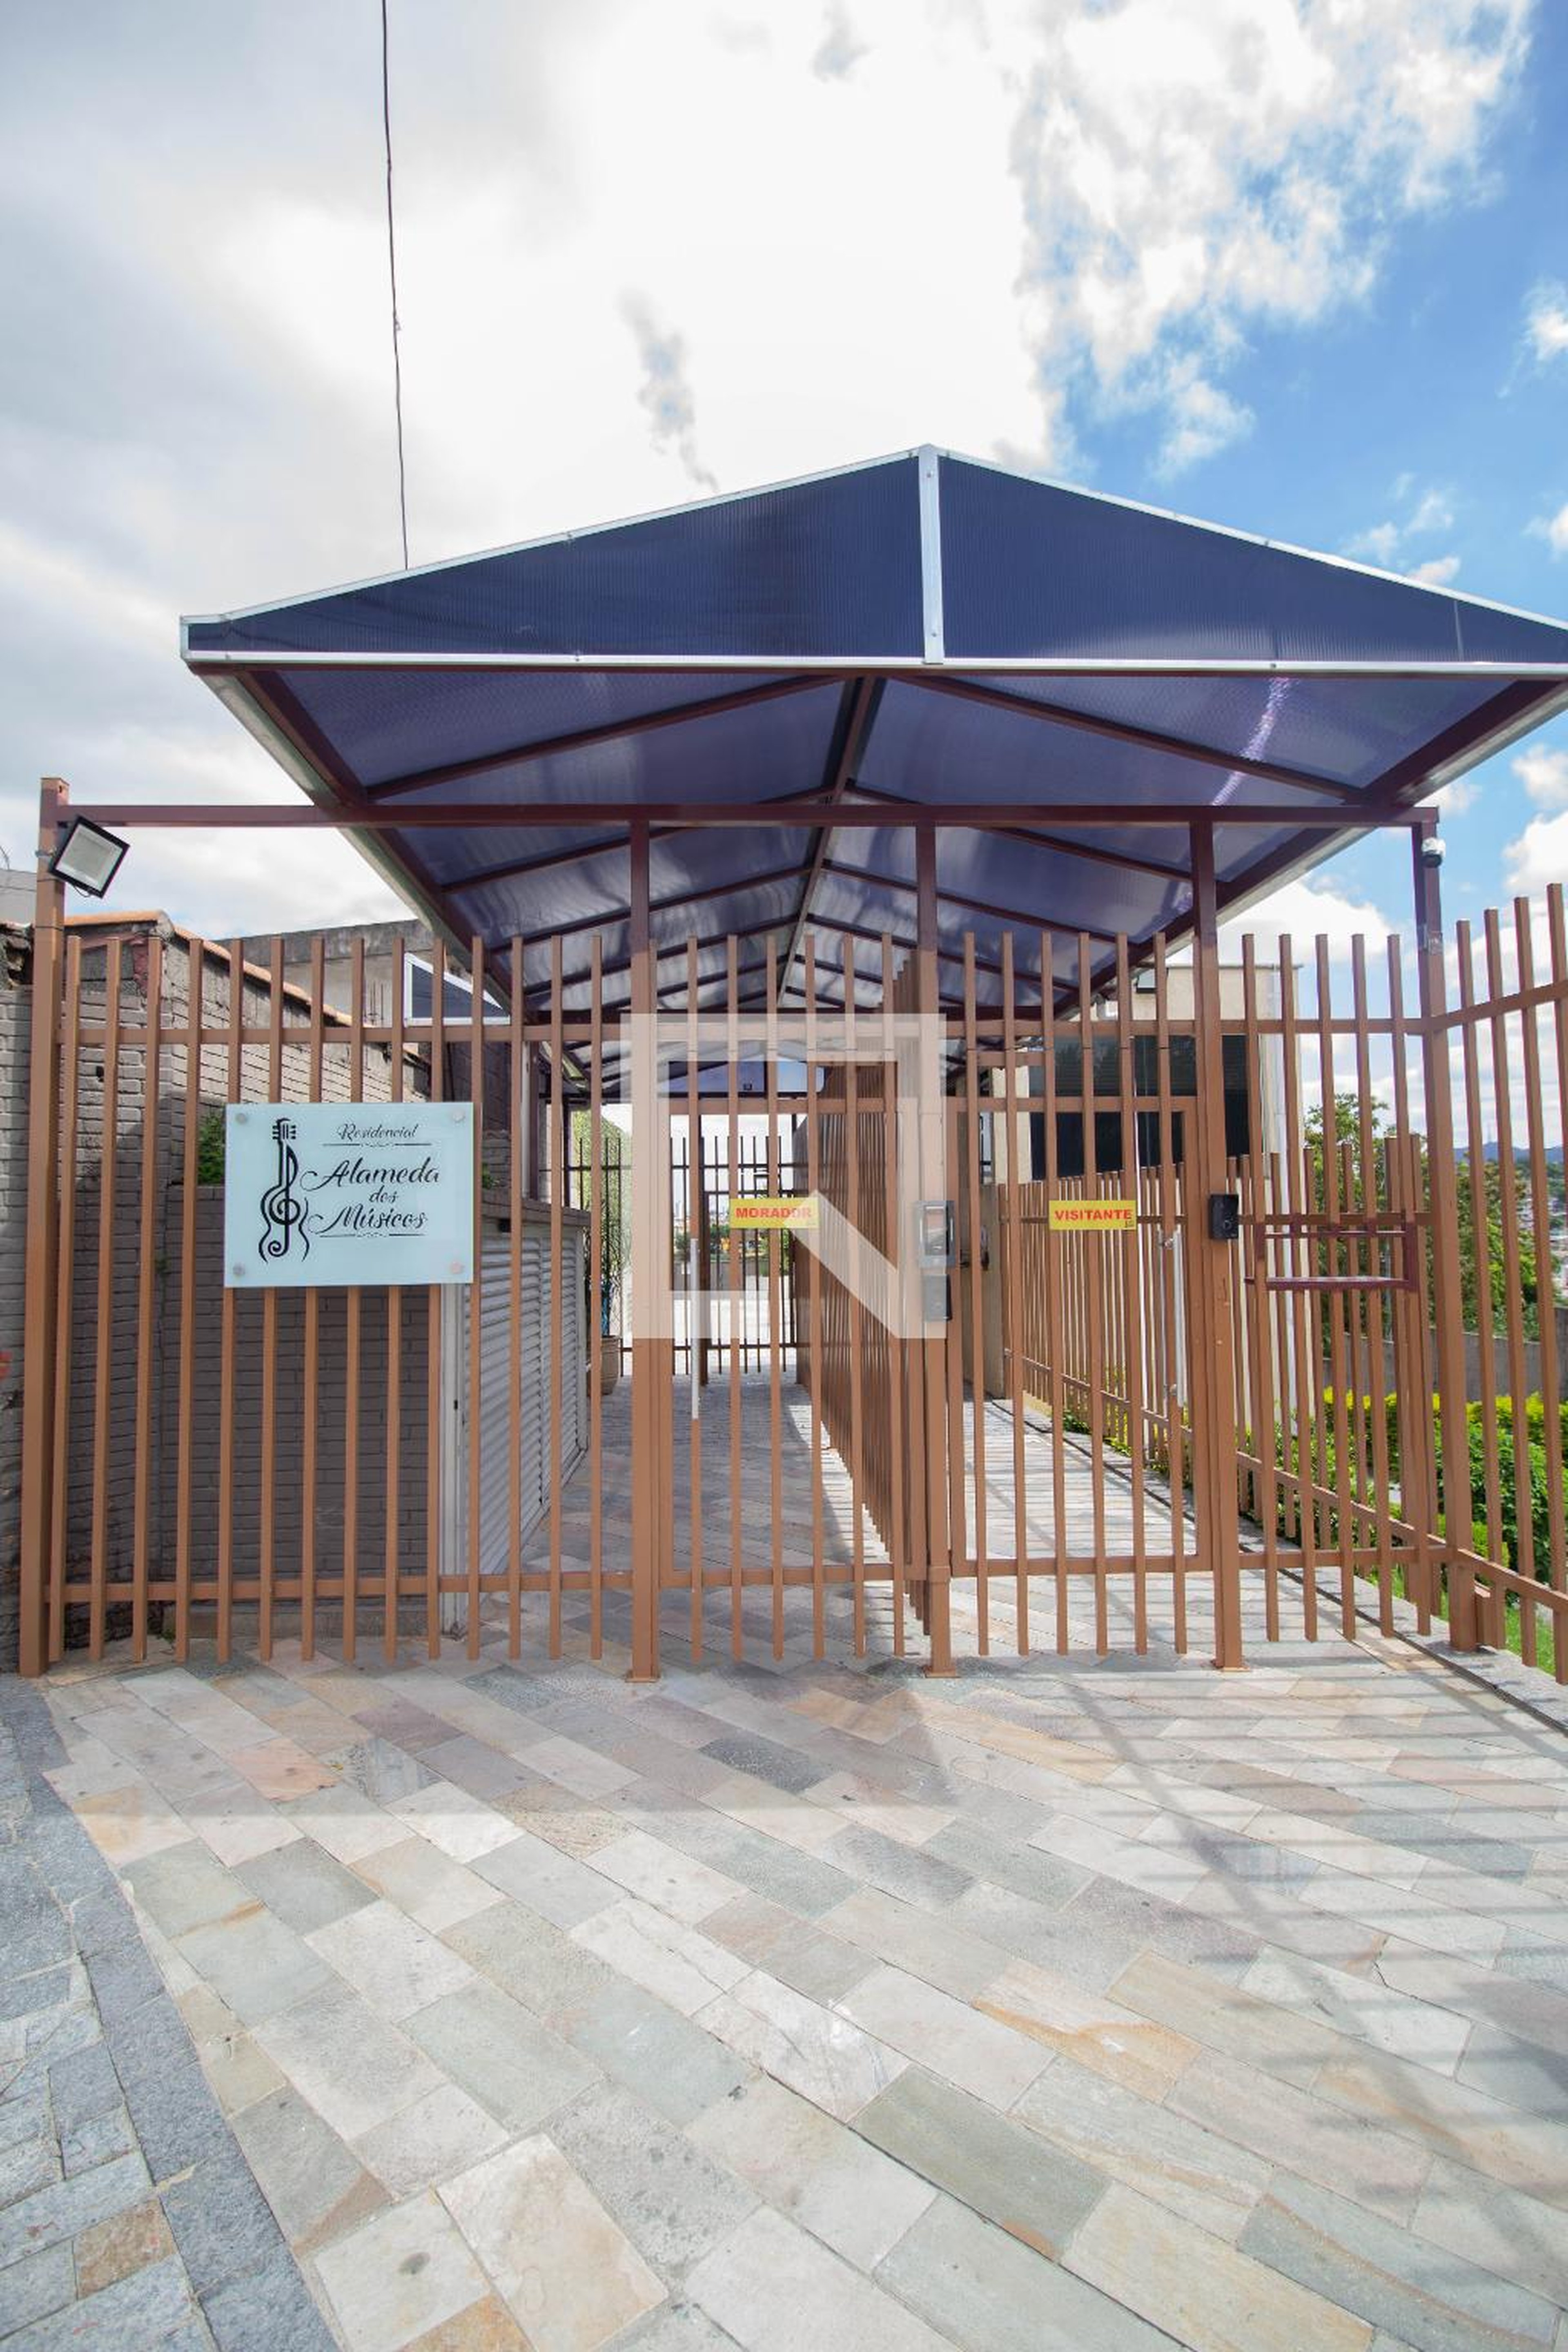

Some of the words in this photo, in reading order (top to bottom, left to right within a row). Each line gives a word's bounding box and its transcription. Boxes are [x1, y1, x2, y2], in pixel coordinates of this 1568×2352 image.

[337, 1123, 419, 1141] Residencial
[300, 1156, 440, 1192] Alameda
[369, 1185, 399, 1203] dos
[307, 1204, 428, 1234] Músicos
[736, 1207, 811, 1218] MORADOR
[1054, 1209, 1132, 1220] VISITANTE
